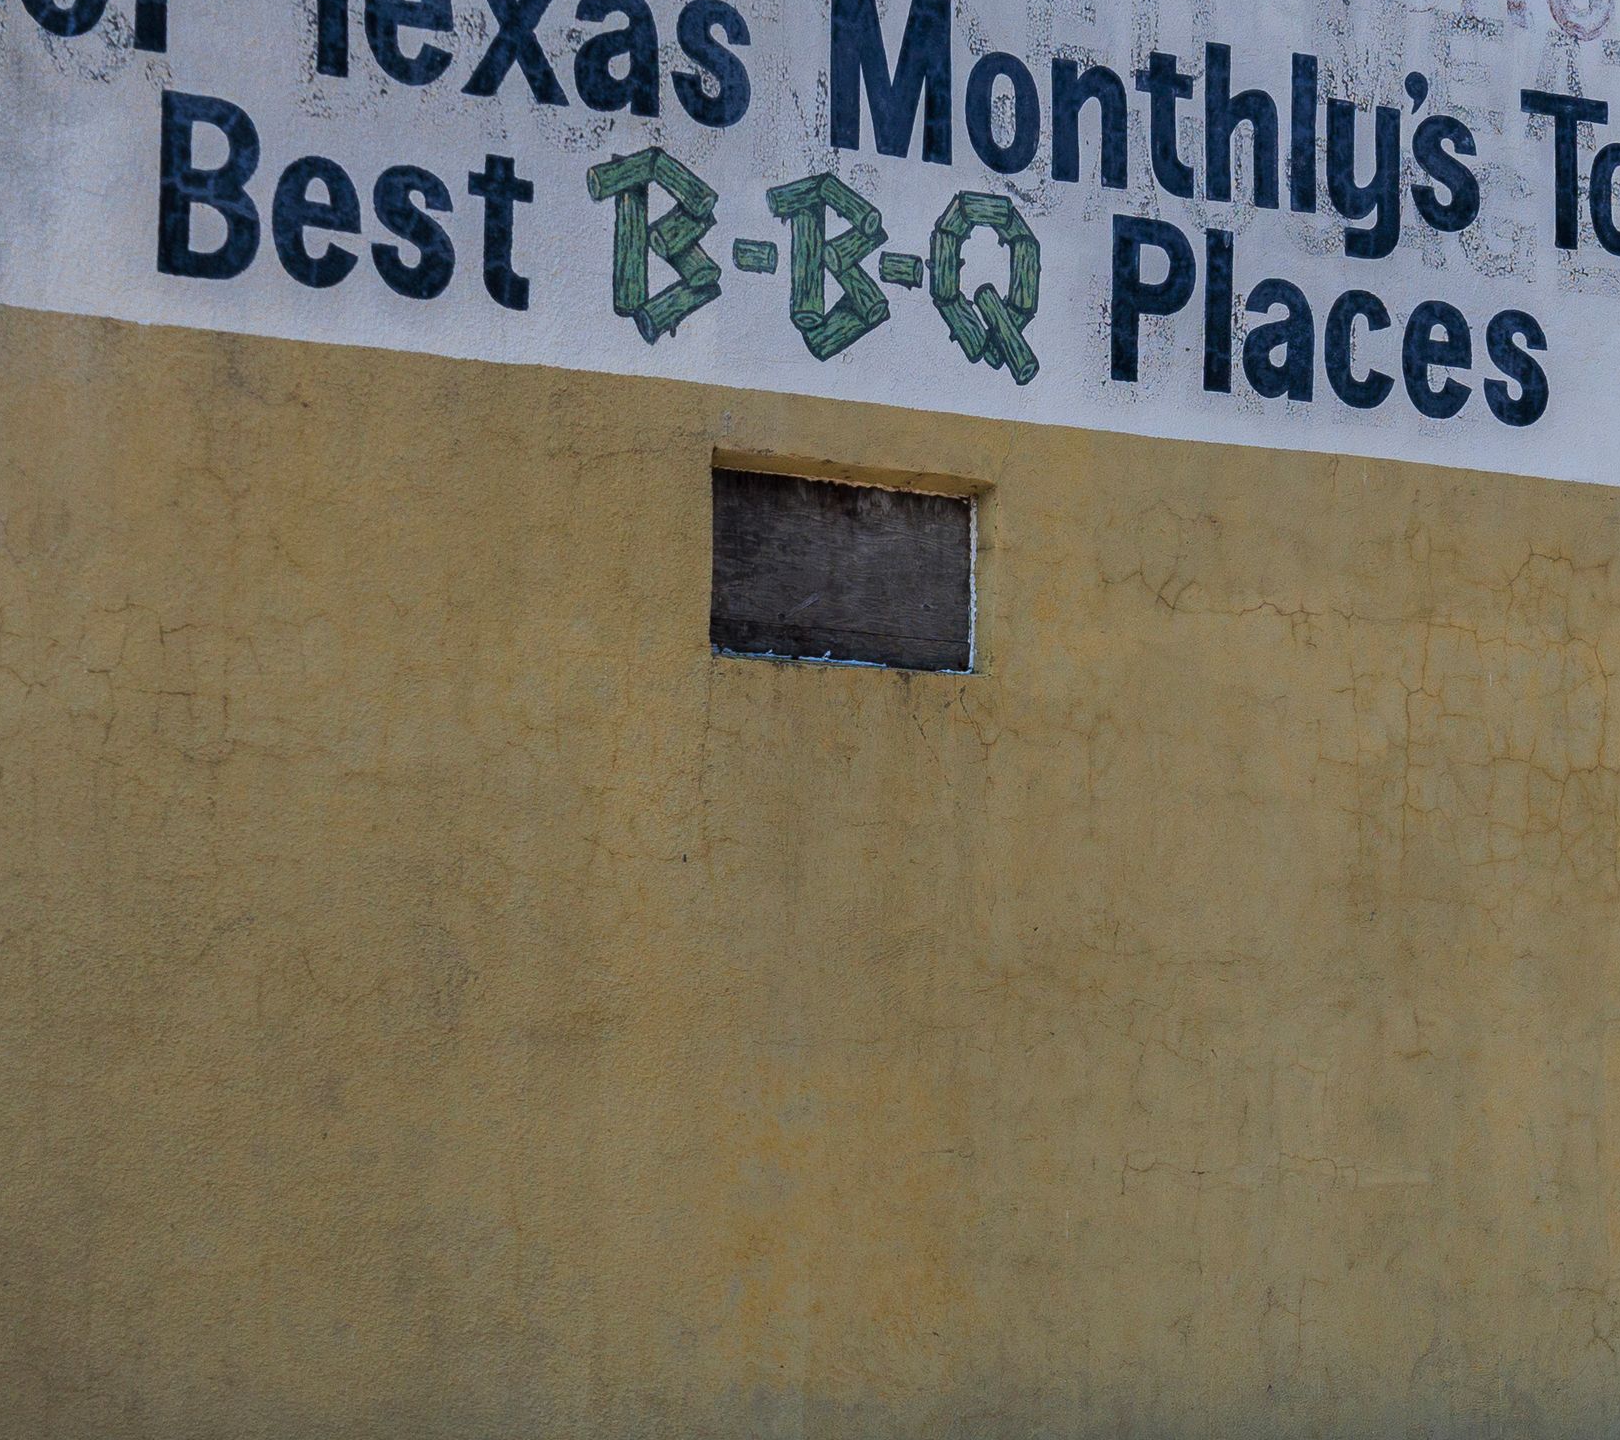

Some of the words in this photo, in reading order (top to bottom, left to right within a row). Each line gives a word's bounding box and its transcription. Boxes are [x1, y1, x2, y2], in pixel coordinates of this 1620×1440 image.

[157, 90, 534, 311] Best
[587, 145, 1040, 387] B-B-Q
[1110, 214, 1549, 427] Places
